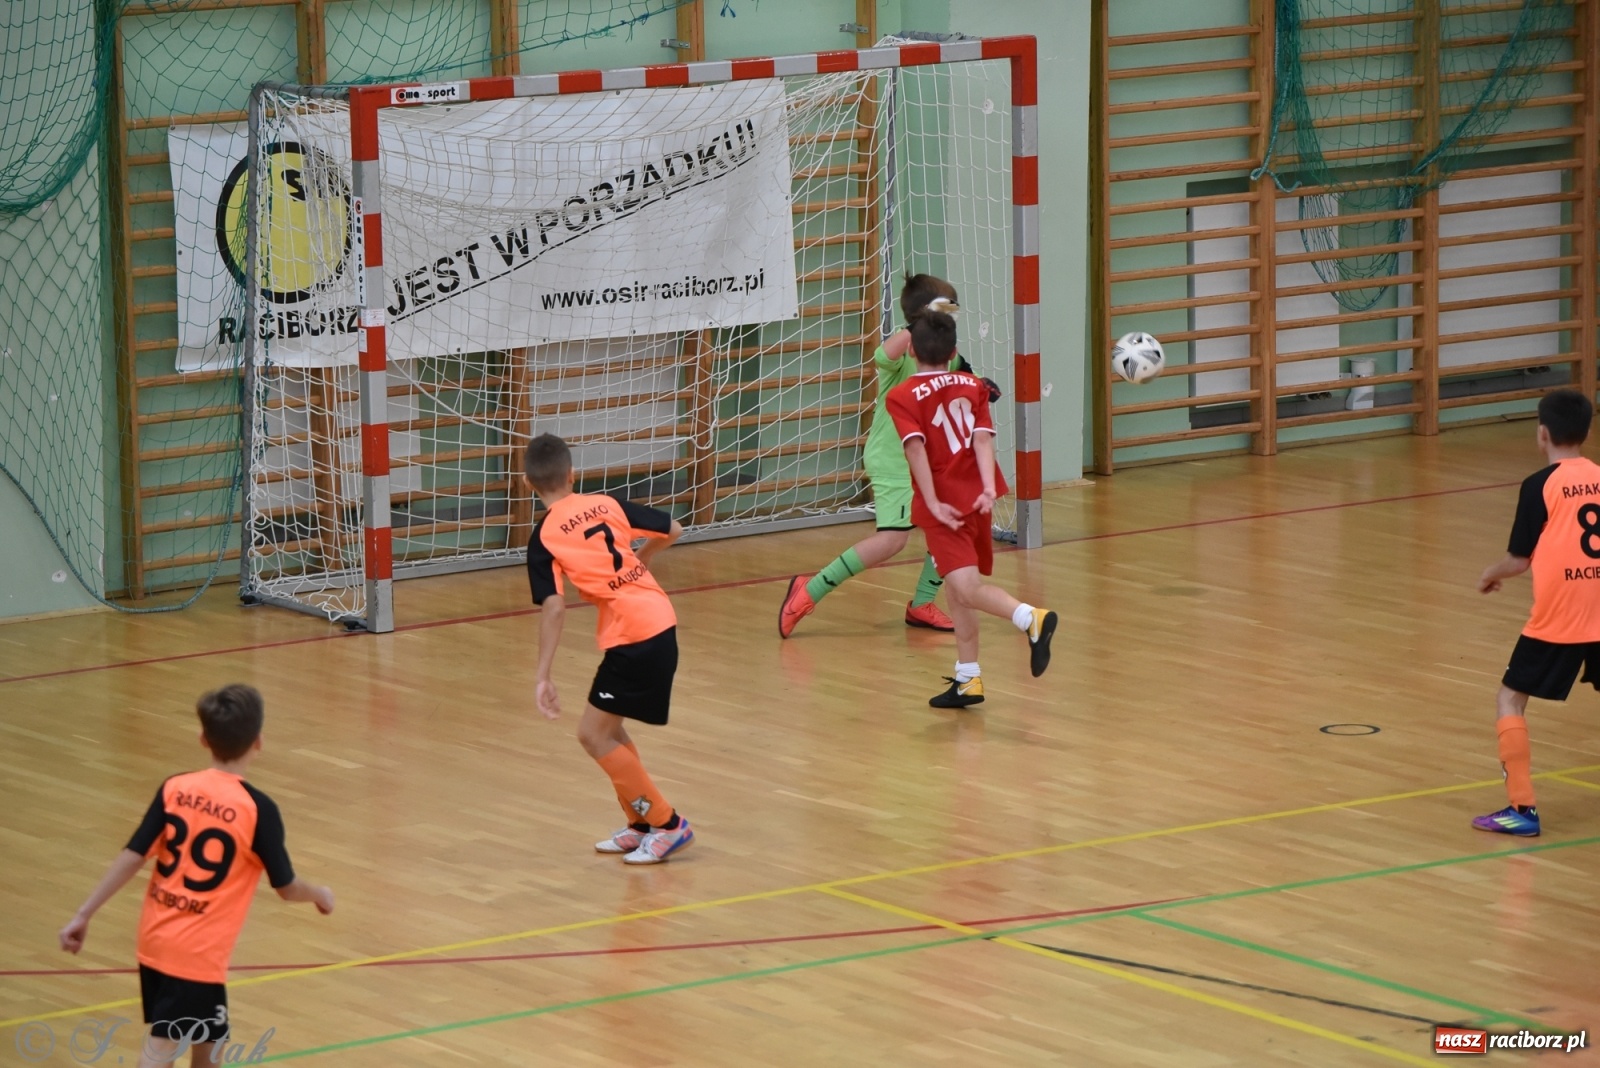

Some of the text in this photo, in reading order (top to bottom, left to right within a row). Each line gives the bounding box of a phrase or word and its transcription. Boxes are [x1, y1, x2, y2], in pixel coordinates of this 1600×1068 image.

[427, 86, 456, 100] sport
[387, 242, 481, 316] JEST
[490, 223, 529, 267] W
[541, 267, 765, 311] www.osirraciborz.pl
[219, 304, 358, 344] RCIBORZ
[911, 374, 977, 401] ZS KIETRZ
[931, 396, 976, 455] 10
[560, 504, 609, 535] RAFAKO
[1577, 502, 1600, 559] 8
[583, 522, 623, 573] 7
[156, 812, 237, 892] 39
[213, 1004, 227, 1026] 3
